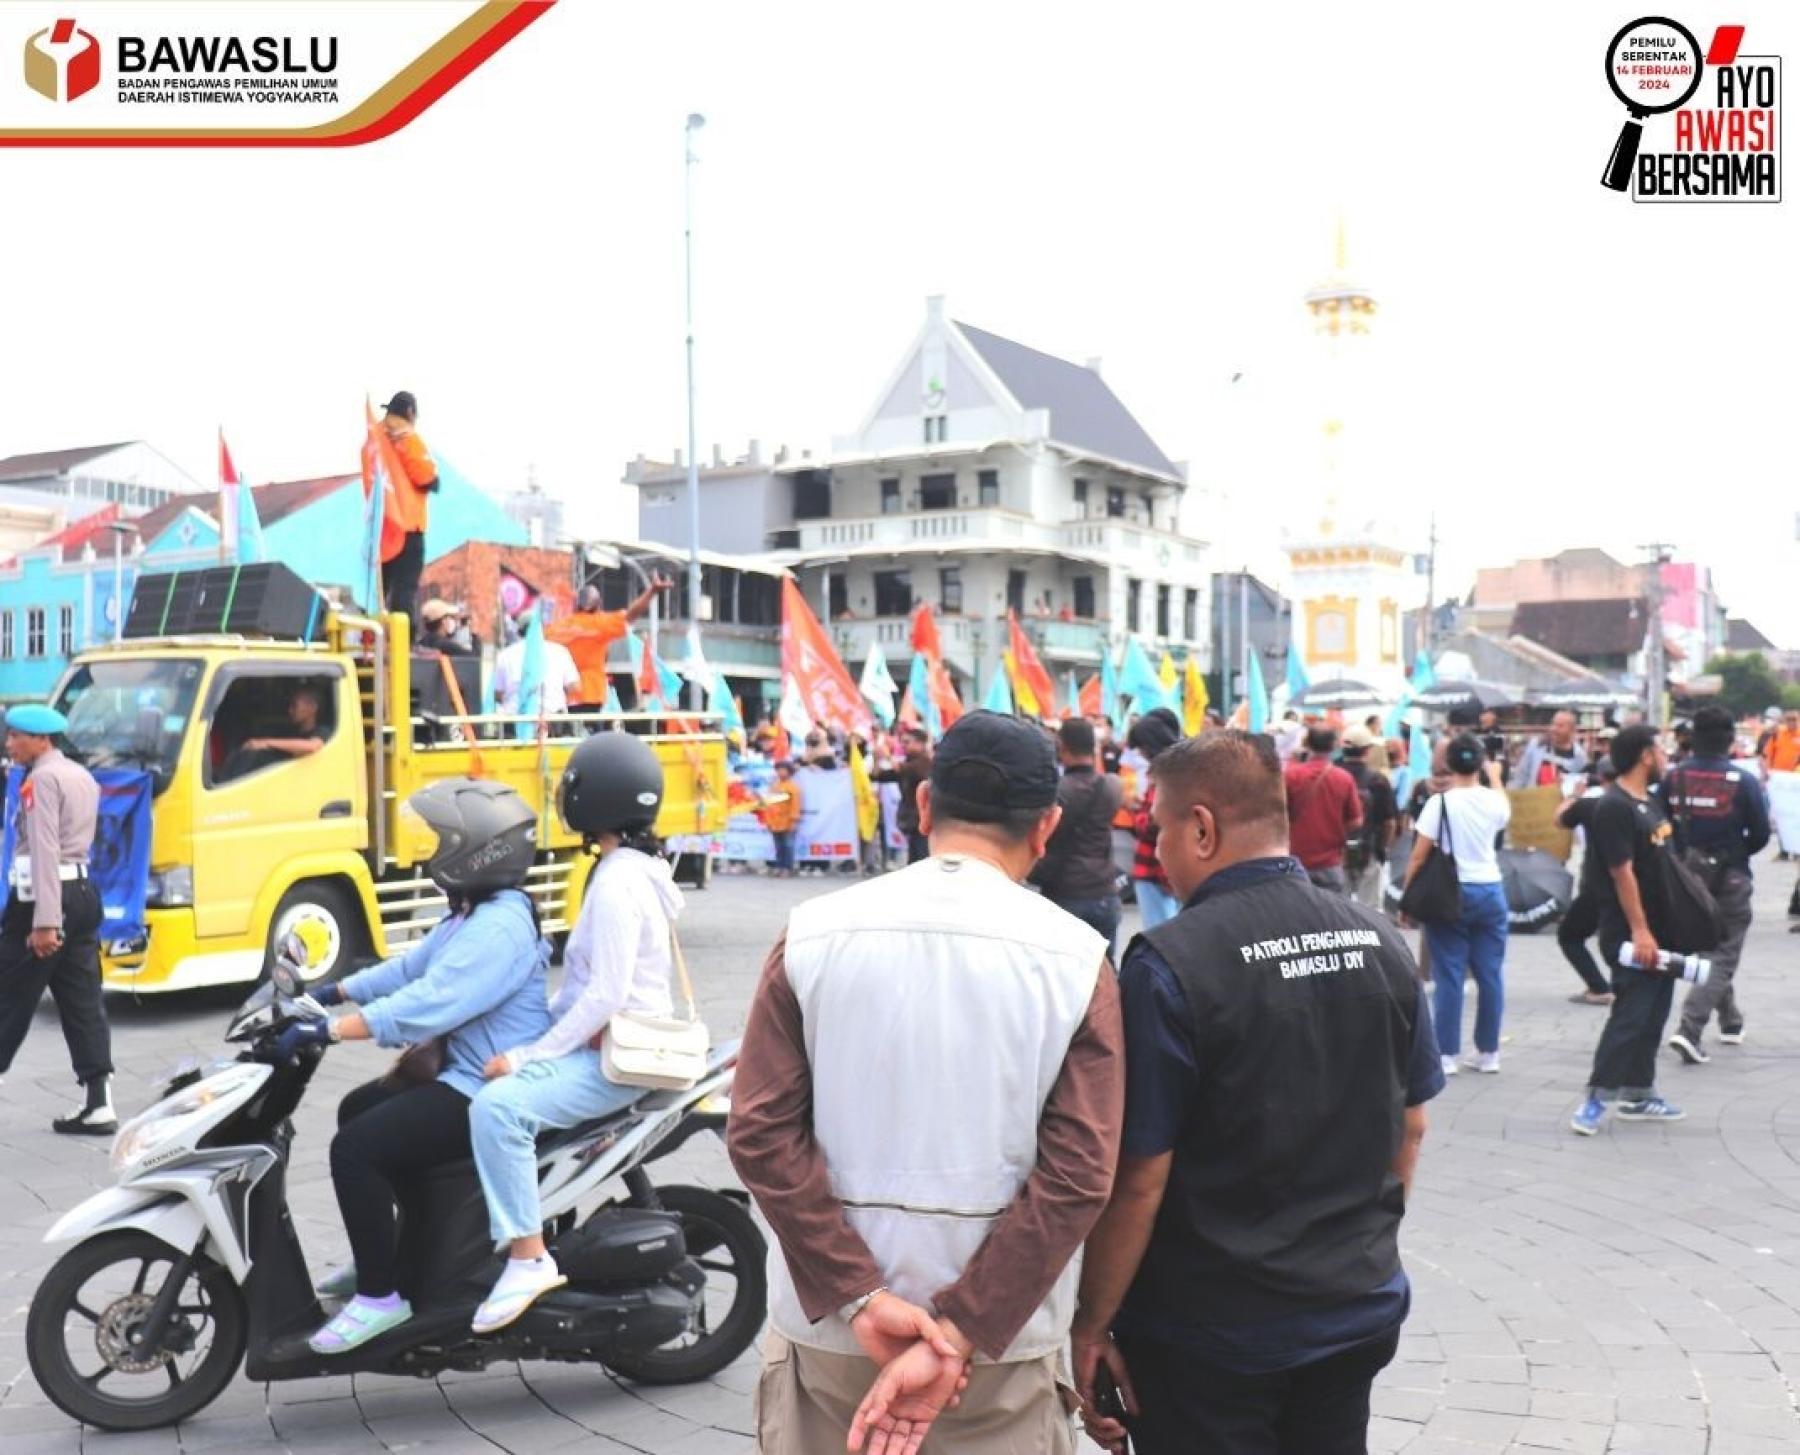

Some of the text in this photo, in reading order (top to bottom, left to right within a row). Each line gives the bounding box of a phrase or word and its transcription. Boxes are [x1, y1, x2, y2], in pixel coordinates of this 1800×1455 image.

[1240, 928, 1382, 964] PATROLI PENGAWASAN
[1279, 950, 1365, 979] BAWASLU DIY
